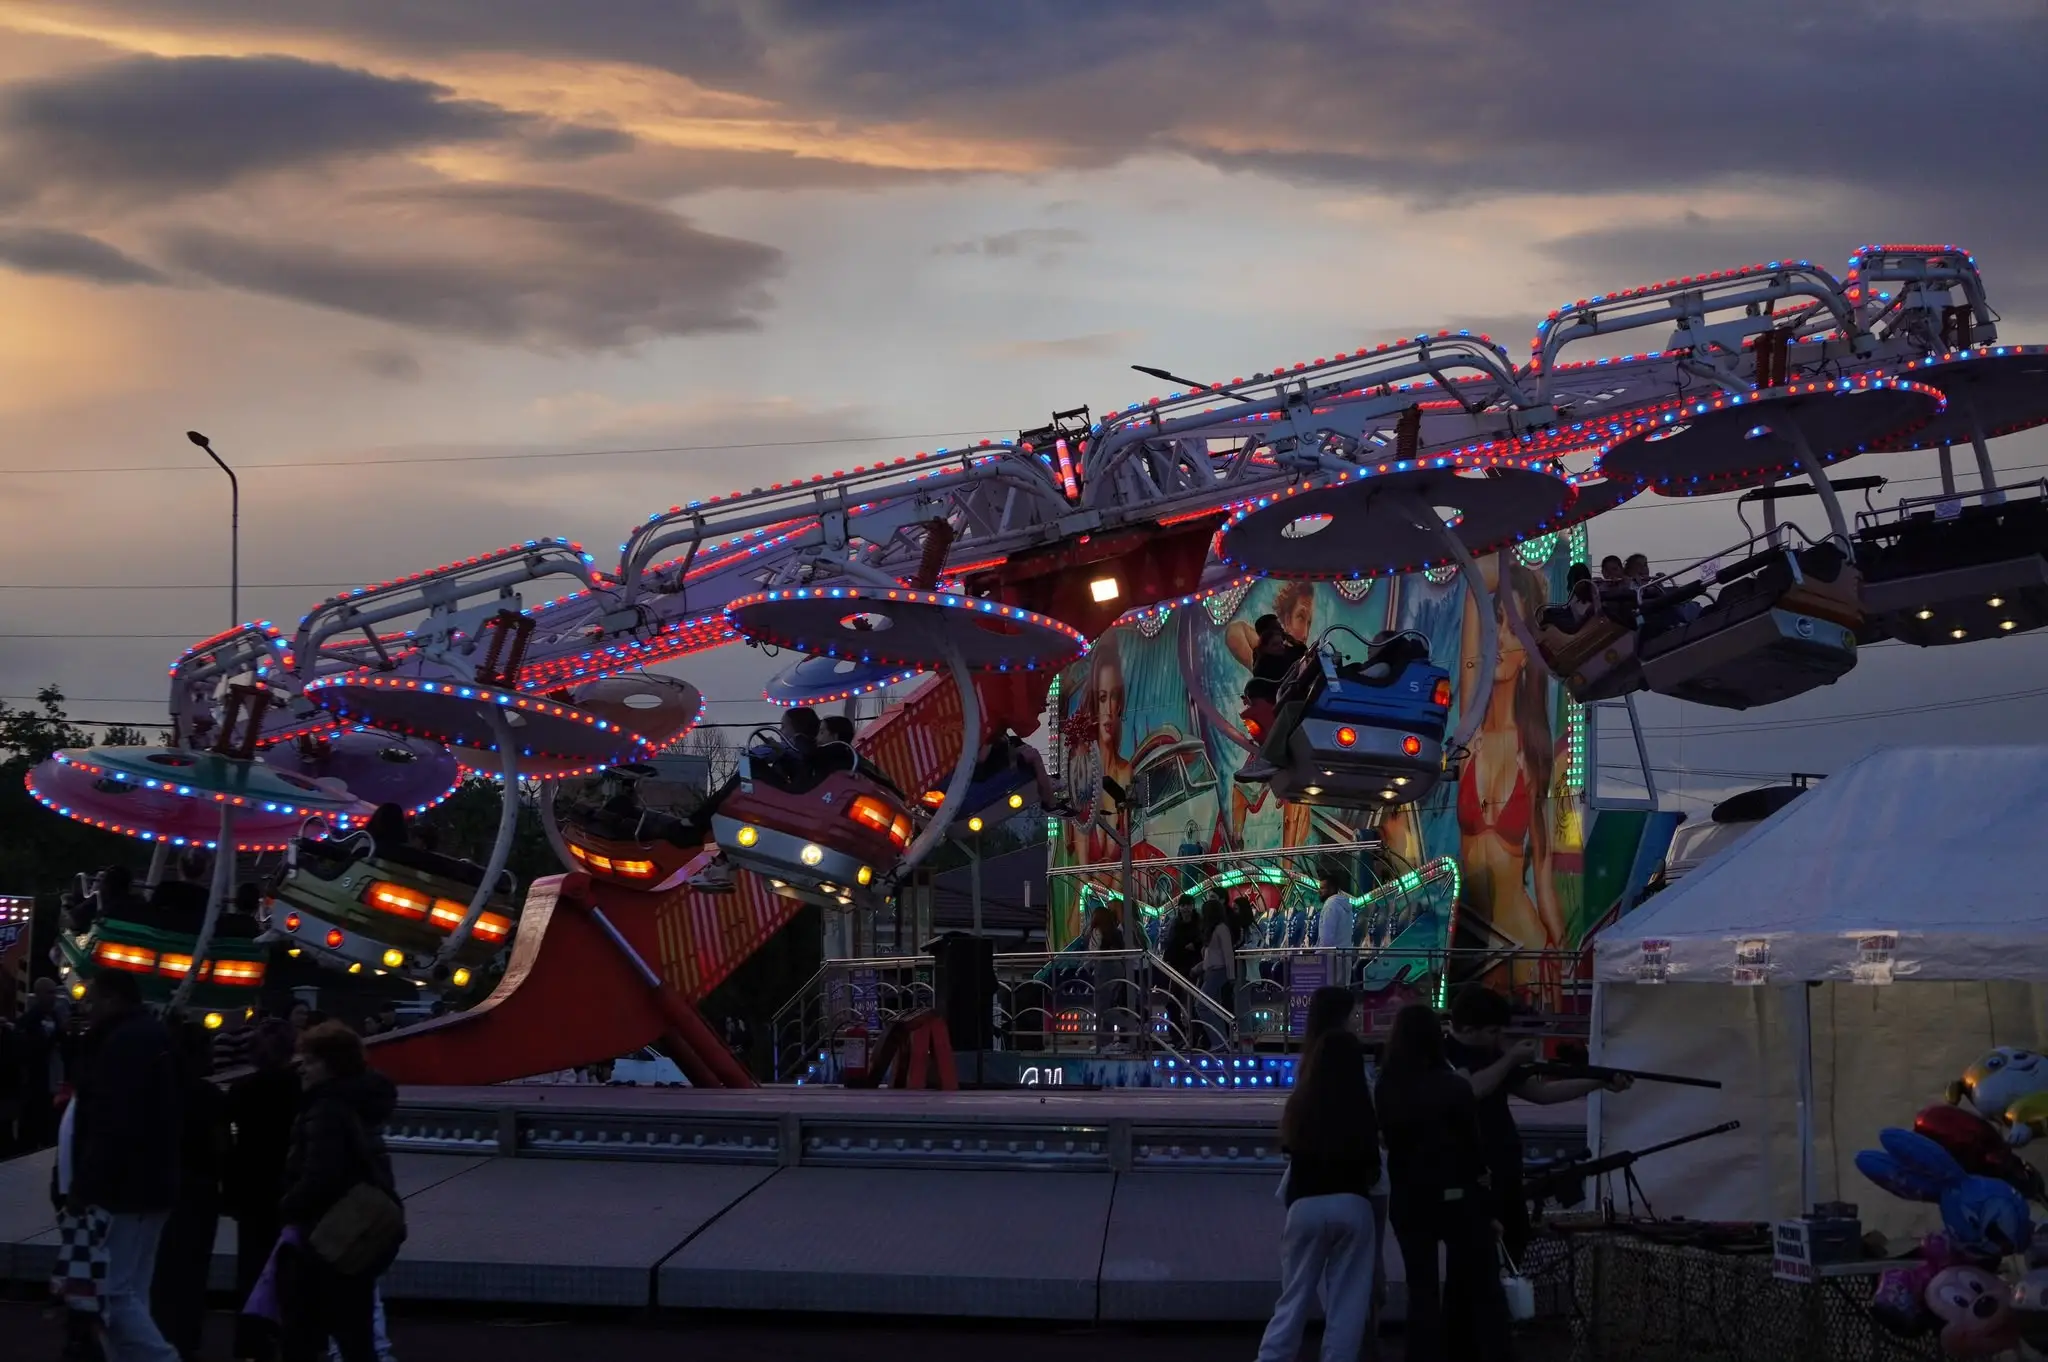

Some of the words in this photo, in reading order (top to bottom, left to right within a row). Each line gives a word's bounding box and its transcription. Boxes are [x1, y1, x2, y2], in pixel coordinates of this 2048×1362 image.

[1410, 681, 1419, 693] 5
[821, 791, 832, 804] 4
[342, 876, 351, 888] 3
